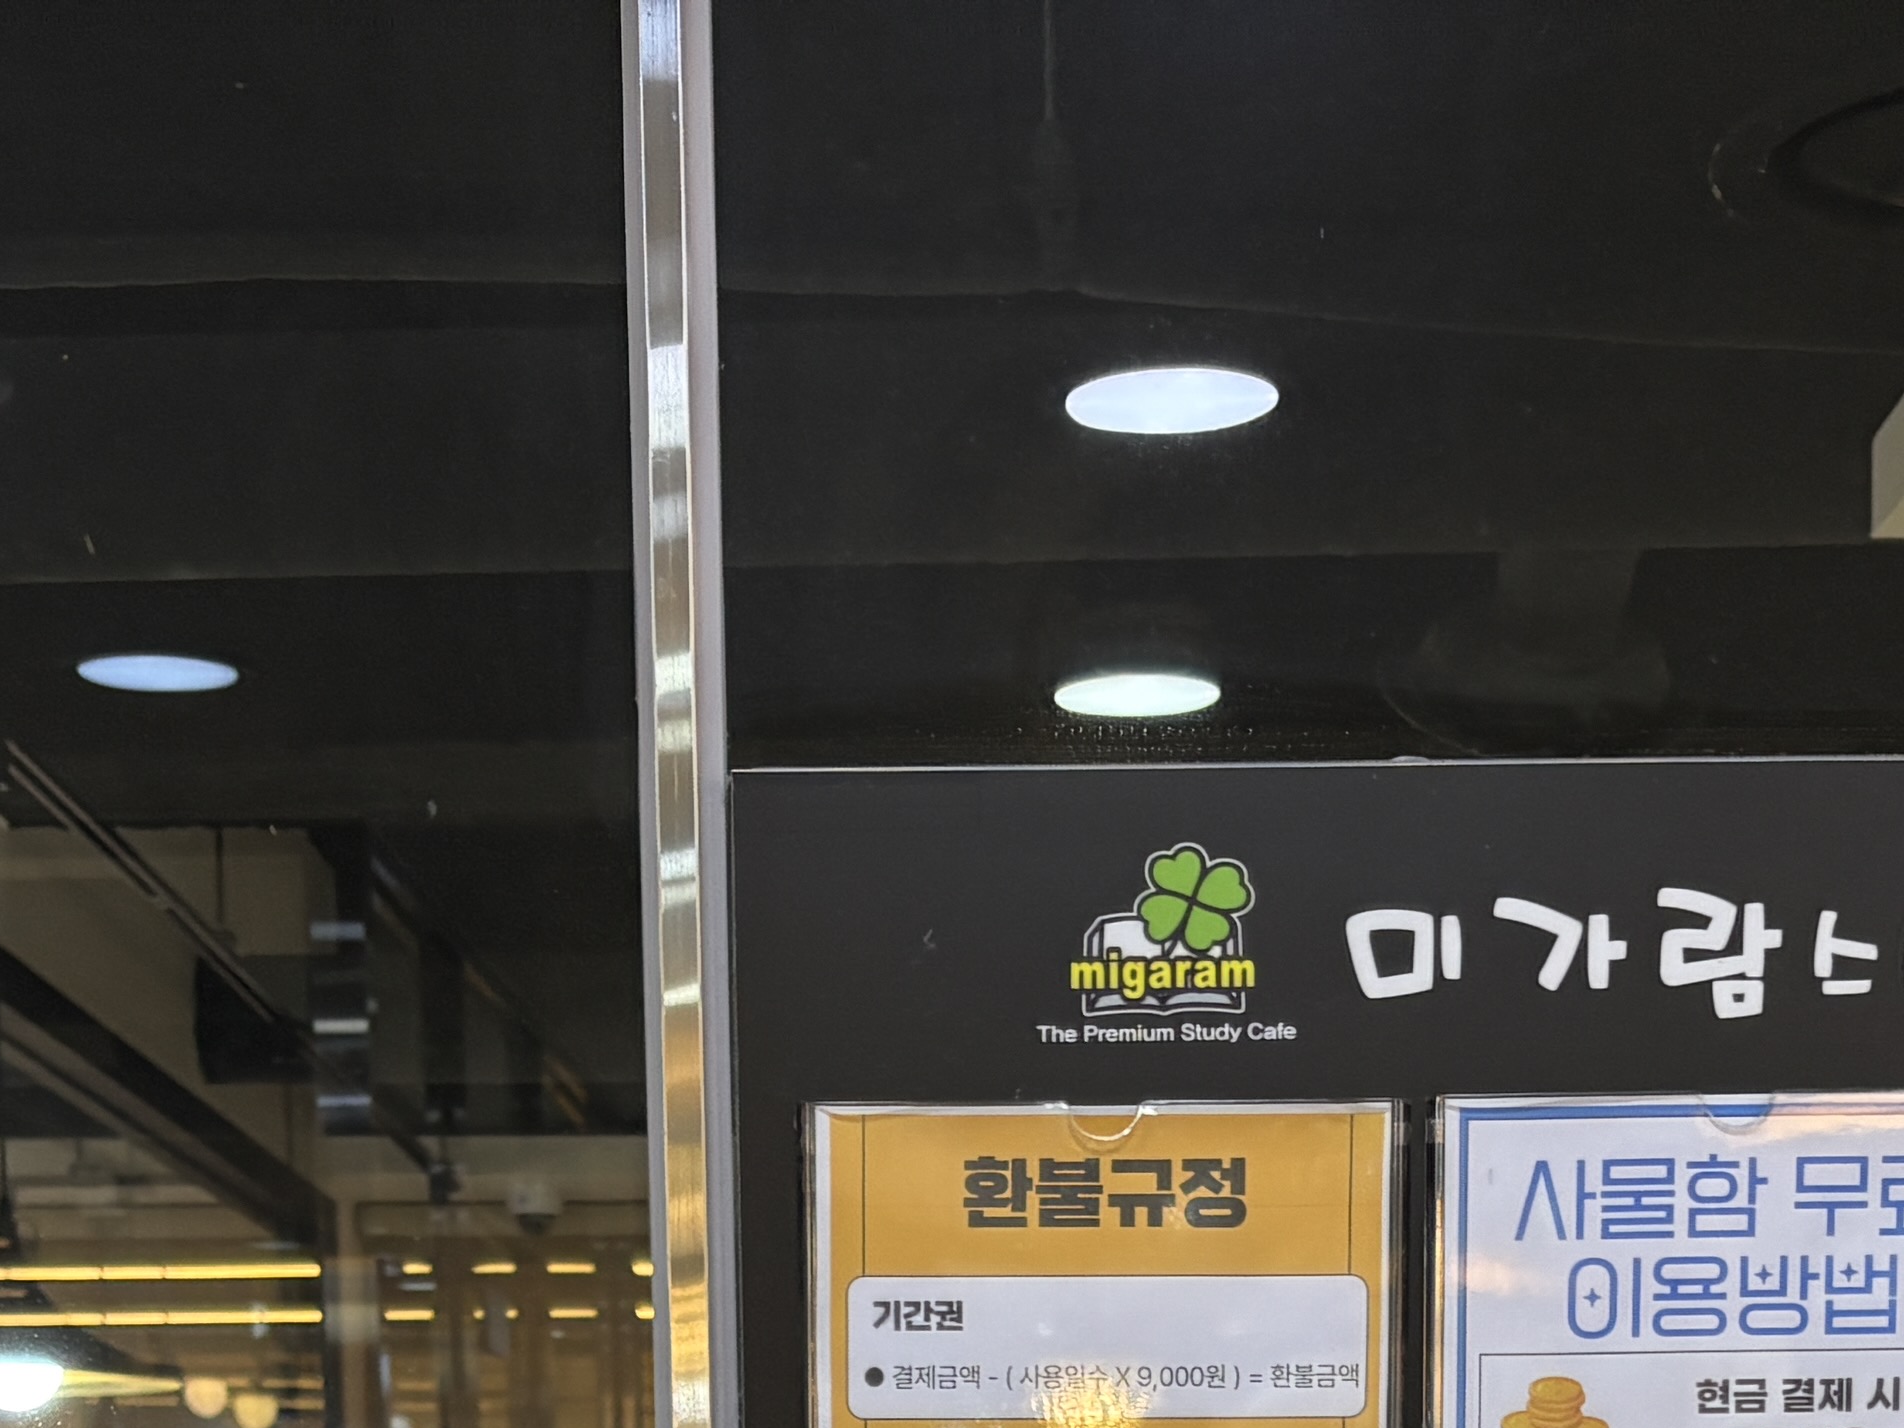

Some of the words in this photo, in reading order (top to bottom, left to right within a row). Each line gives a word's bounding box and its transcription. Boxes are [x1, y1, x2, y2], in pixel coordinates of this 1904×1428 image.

[1070, 952, 1256, 999] migaram
[1037, 1025, 1077, 1043] The
[1084, 1024, 1174, 1042] Premium
[1180, 1023, 1242, 1043] Study
[1247, 1022, 1297, 1040] Cafe
[962, 1156, 1247, 1228] 환불규정
[1515, 1154, 1768, 1241] 사물함
[872, 1299, 965, 1331] 기간권
[1567, 1254, 1898, 1339] 이용방법
[892, 1364, 982, 1389] 결제금액
[1116, 1365, 1132, 1387] X
[1136, 1363, 1227, 1394] 9,000원
[1269, 1363, 1361, 1388] 환불금액
[1696, 1378, 1769, 1414] 현금
[1782, 1377, 1853, 1412] 결제
[1866, 1376, 1900, 1410] 시
